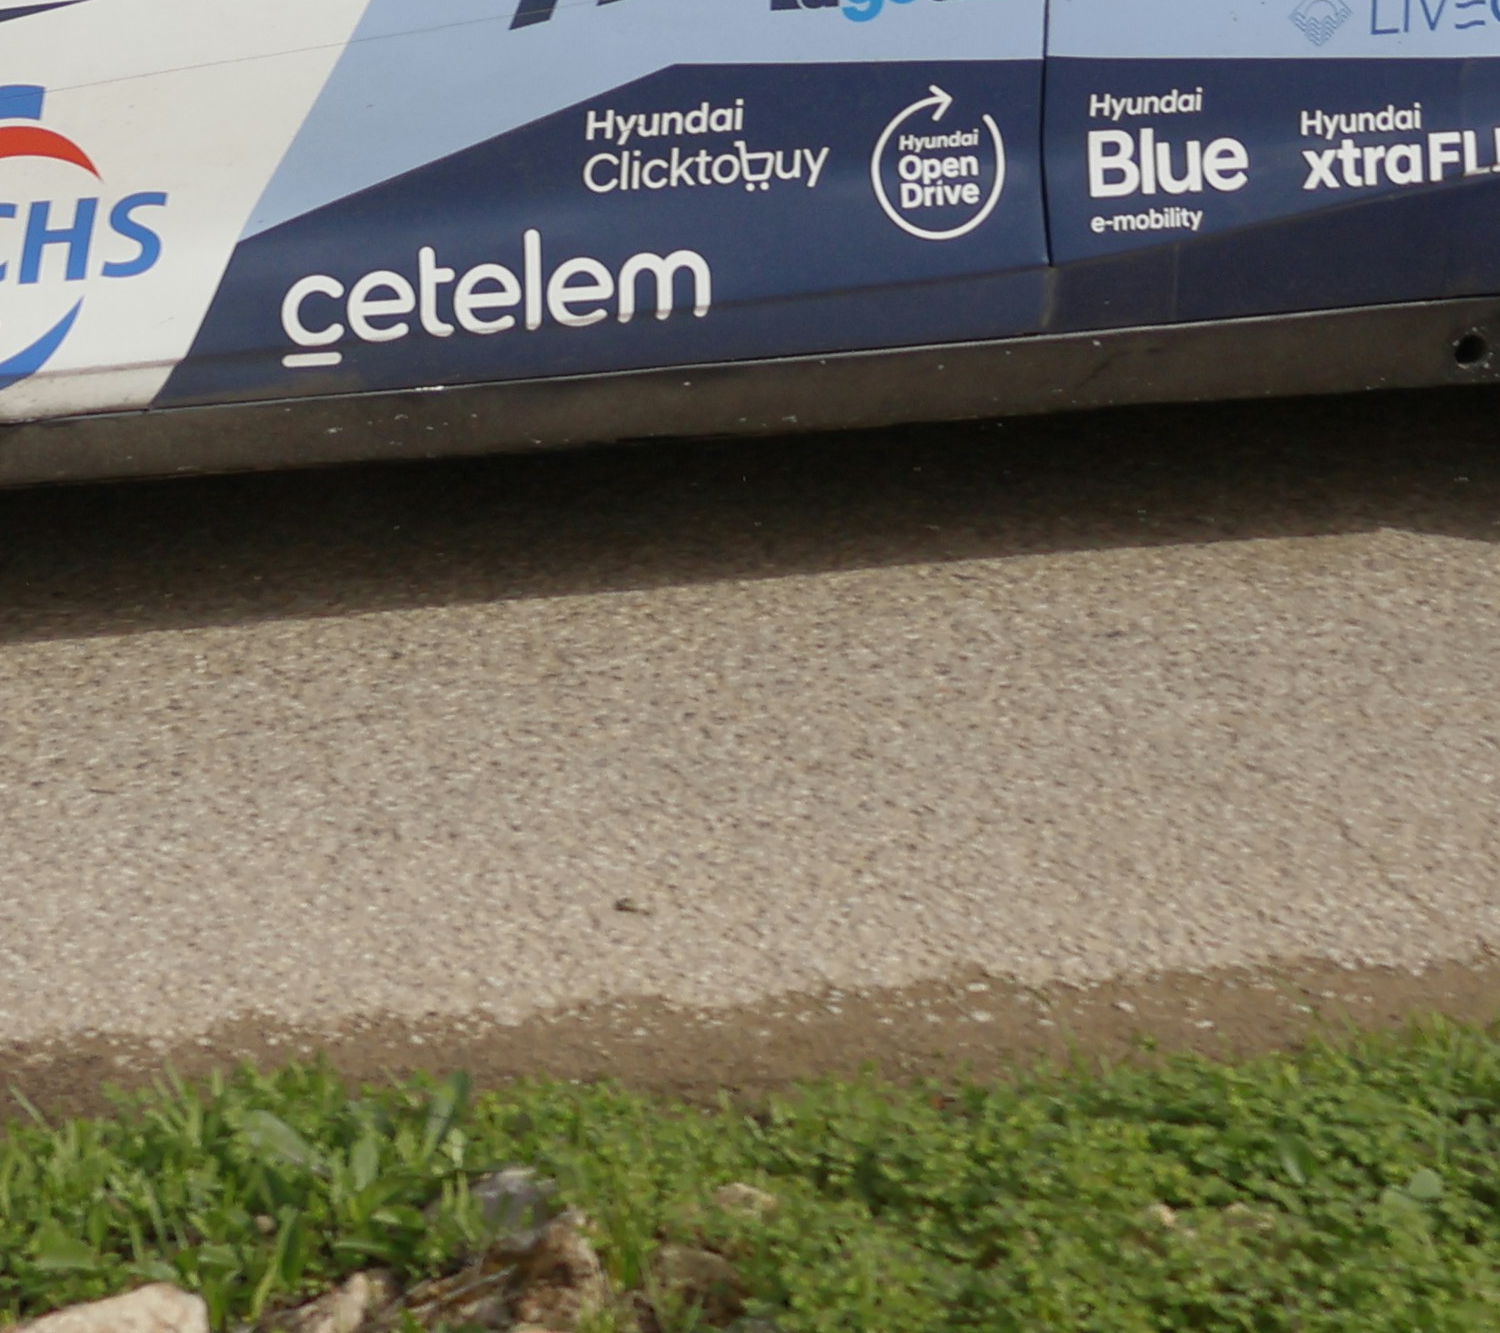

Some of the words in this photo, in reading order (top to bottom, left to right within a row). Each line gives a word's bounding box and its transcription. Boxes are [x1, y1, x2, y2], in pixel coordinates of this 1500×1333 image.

[1089, 88, 1203, 120] Hyundai
[1301, 103, 1422, 139] Hyundai
[585, 99, 744, 146] Hyundai
[899, 129, 979, 154] Hyundai
[583, 140, 830, 193] Clicktobuy
[899, 153, 979, 183] Open
[1088, 128, 1249, 199] Blue
[900, 180, 980, 210] Drive
[1090, 207, 1203, 233] e-mobility
[281, 229, 712, 368] cetelem
